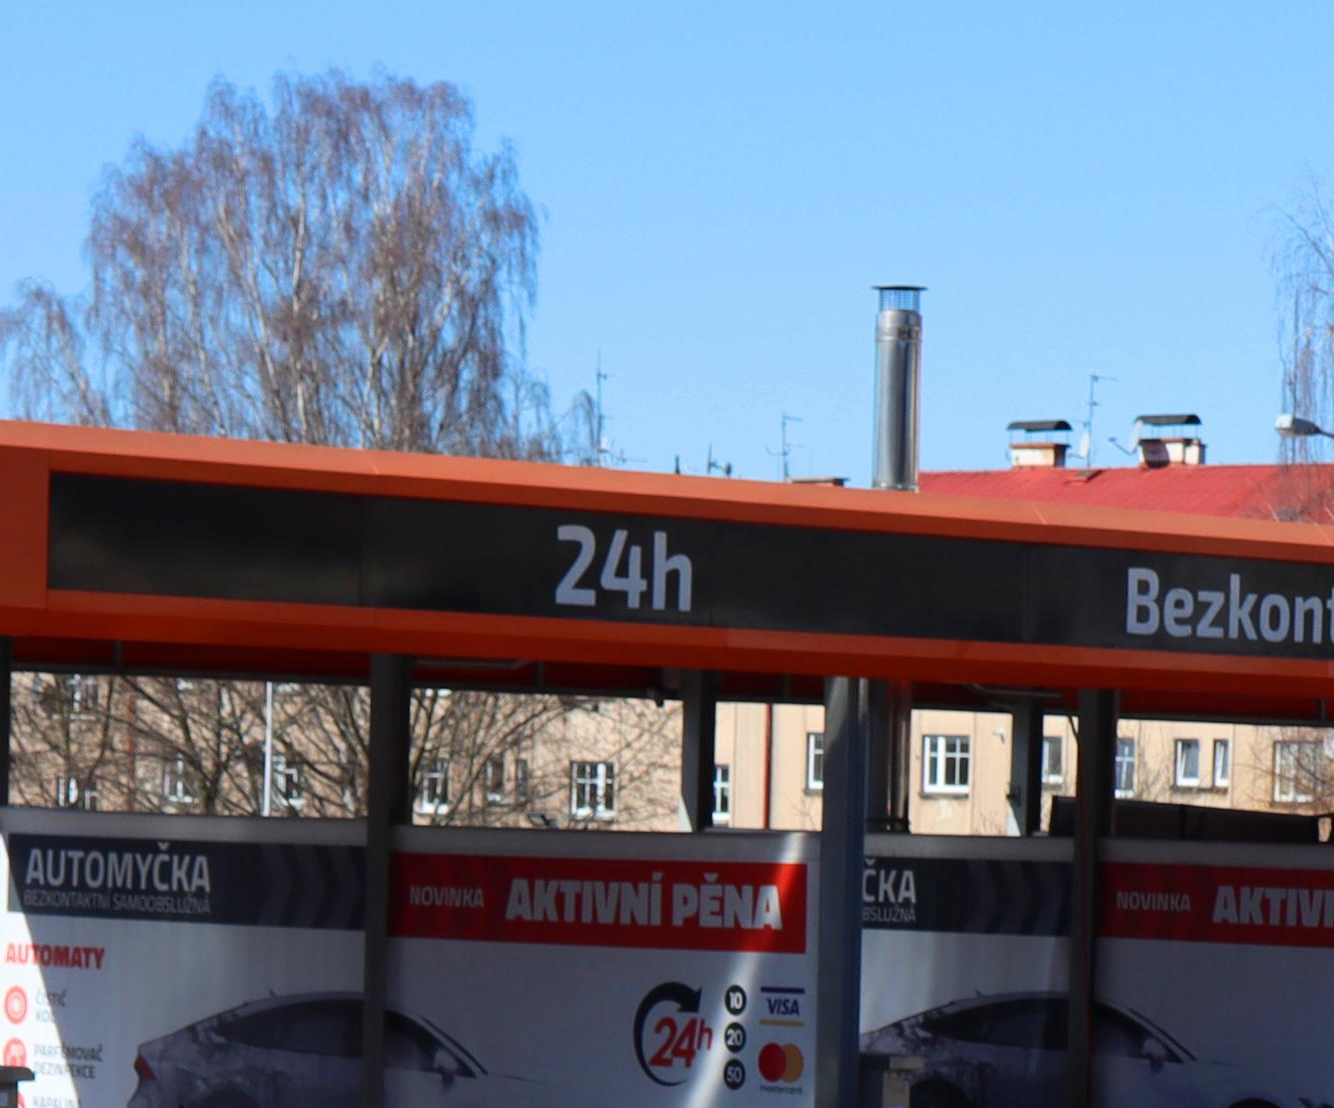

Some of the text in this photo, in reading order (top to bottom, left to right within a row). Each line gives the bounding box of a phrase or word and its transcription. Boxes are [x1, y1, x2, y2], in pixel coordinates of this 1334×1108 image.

[555, 524, 692, 612] 24h
[25, 842, 211, 893] AUTOMYČKA
[409, 872, 783, 930] NOVINKA AKTIVNÍ PĚNA
[1116, 890, 1192, 912] NOVINKA
[5, 943, 105, 969] AUTOMATY
[729, 991, 743, 1009] 10
[767, 998, 799, 1016] VISA
[649, 1016, 713, 1069] 24h
[727, 1028, 743, 1046] 20
[726, 1065, 743, 1083] 50
